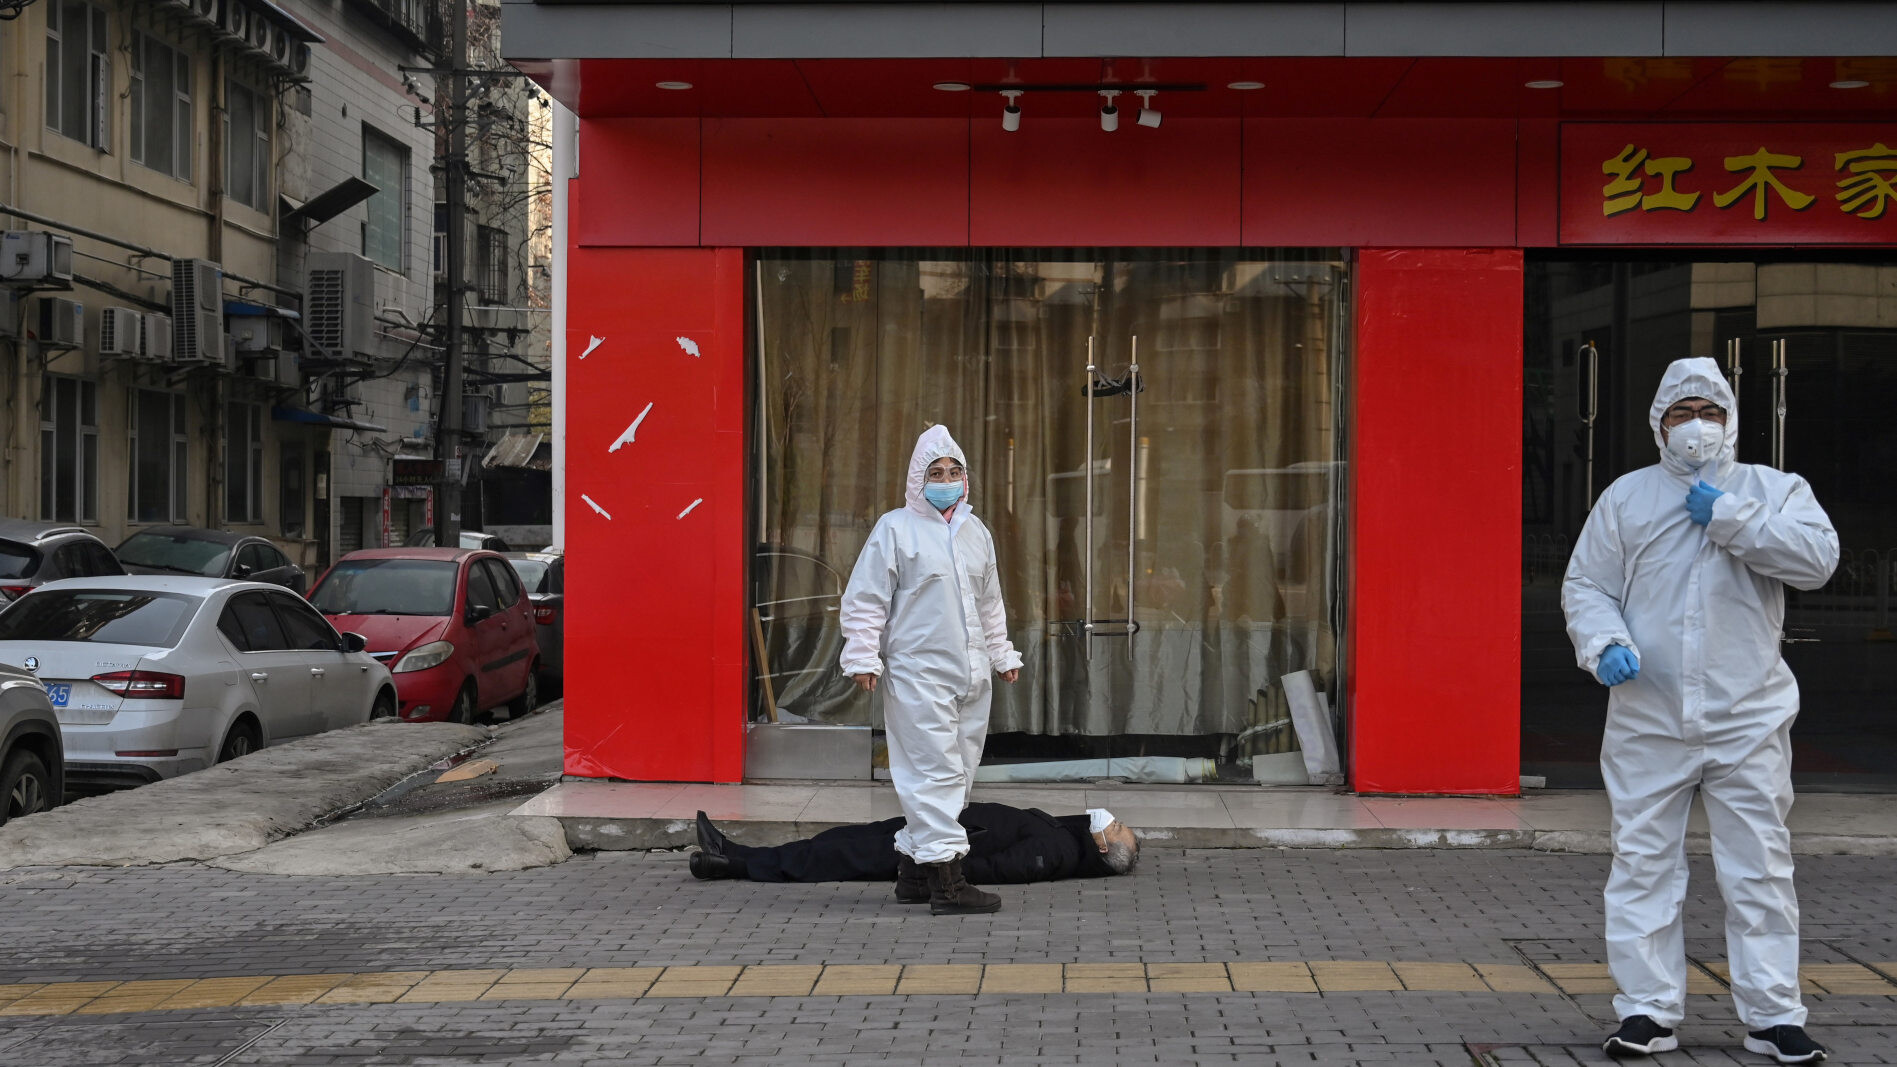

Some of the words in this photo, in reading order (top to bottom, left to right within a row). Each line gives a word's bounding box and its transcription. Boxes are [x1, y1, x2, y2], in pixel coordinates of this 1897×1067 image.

[1602, 143, 1897, 220] 红木家
[45, 685, 69, 703] 65
